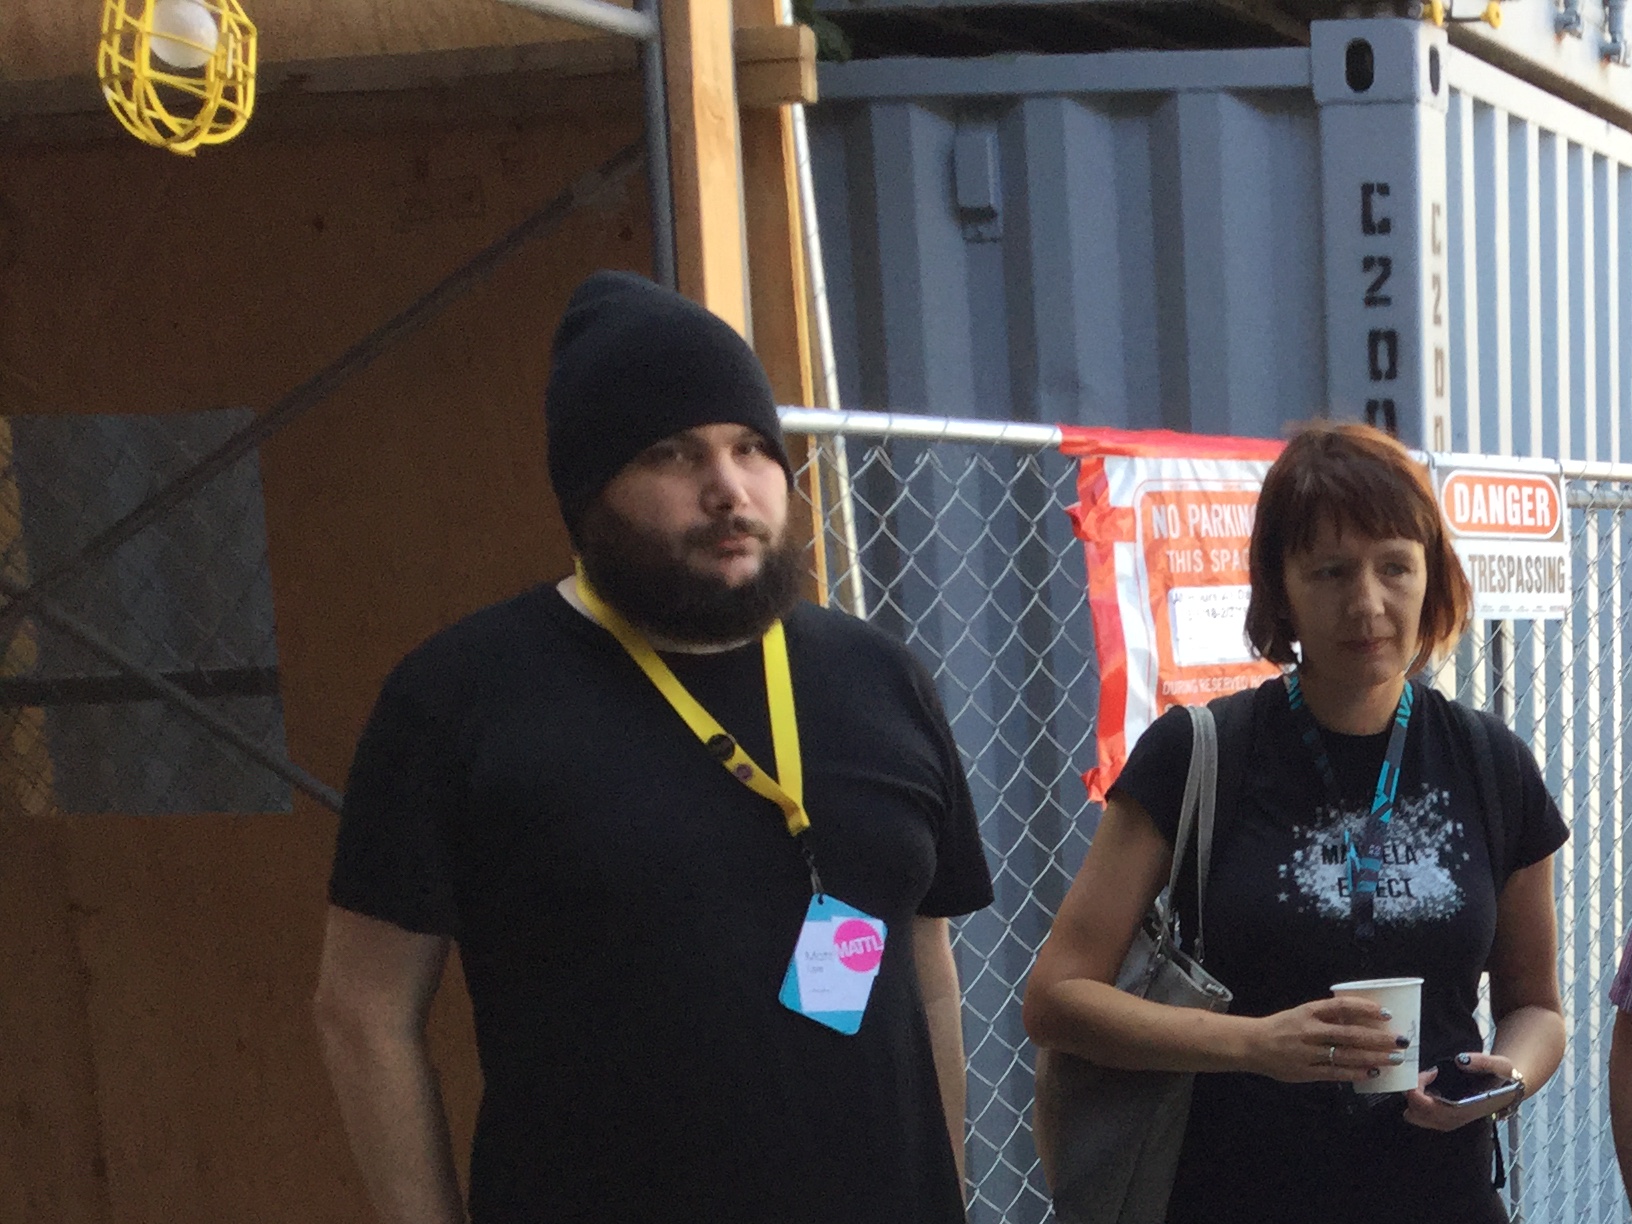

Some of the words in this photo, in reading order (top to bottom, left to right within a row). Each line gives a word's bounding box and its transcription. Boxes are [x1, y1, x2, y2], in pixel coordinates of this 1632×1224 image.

[1453, 482, 1550, 527] DANGER
[1152, 504, 1181, 539] NO
[1167, 549, 1203, 573] THIS
[1210, 549, 1250, 572] SPAC
[1468, 554, 1565, 594] TRESPASSING
[1321, 842, 1418, 866] MAELA
[1338, 876, 1416, 898] EECT
